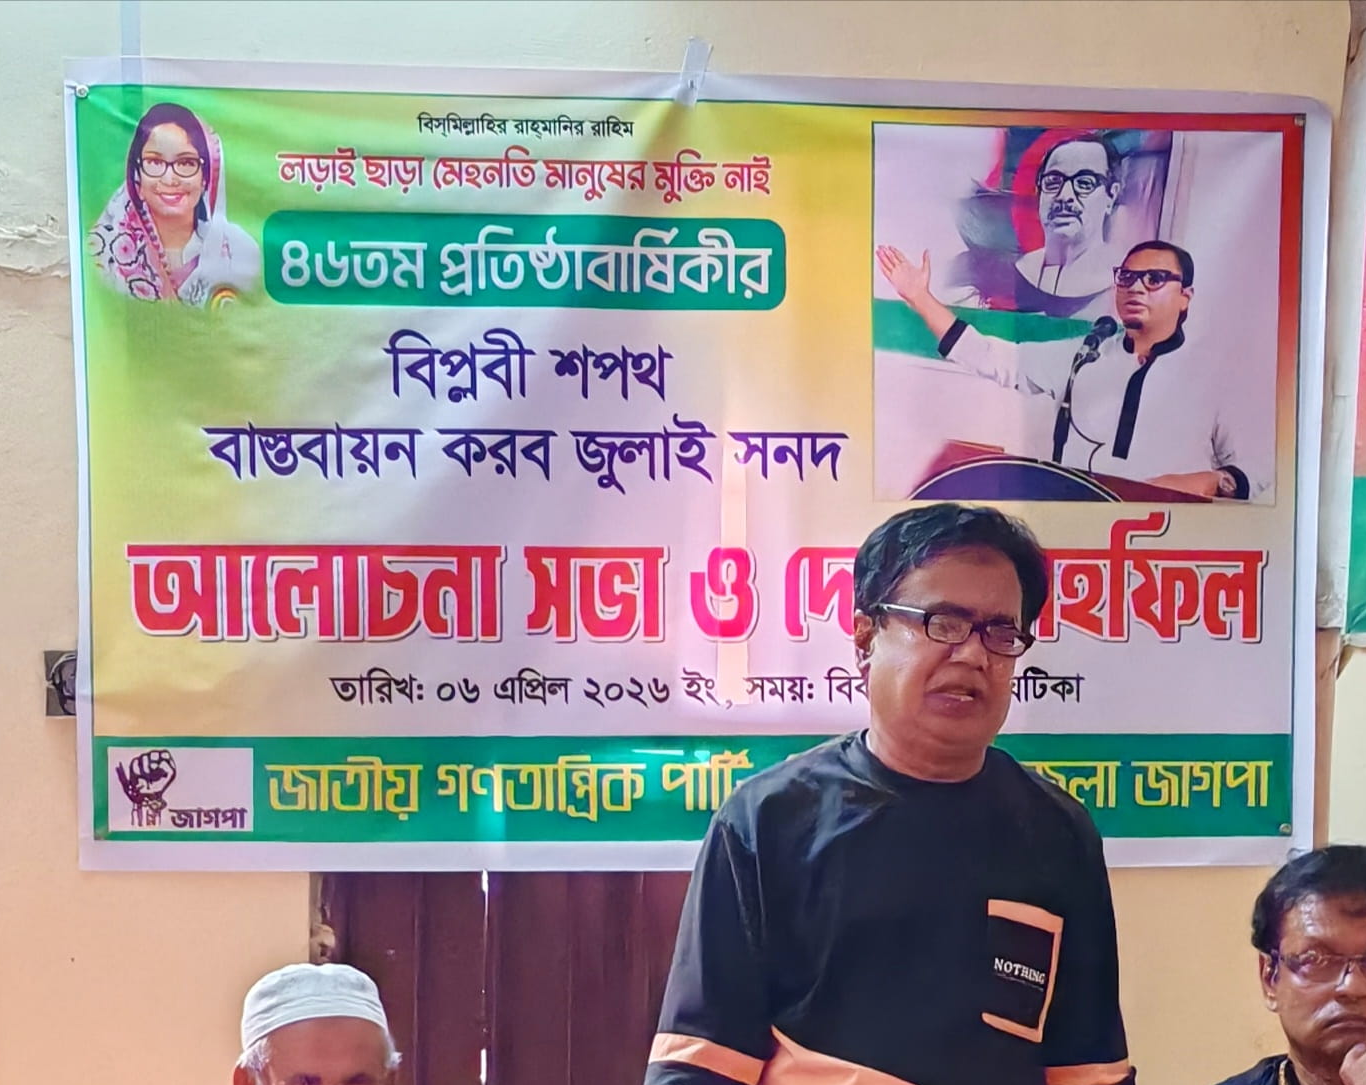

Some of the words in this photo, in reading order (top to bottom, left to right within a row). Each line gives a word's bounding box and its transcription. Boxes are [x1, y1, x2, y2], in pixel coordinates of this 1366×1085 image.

[590, 114, 635, 138] রাহিম
[276, 147, 356, 193] লড়াই
[362, 153, 425, 195] ছাড়া
[433, 144, 536, 192] মেহনতি
[543, 157, 647, 201] মানুষের
[653, 149, 716, 203] মুক্তি
[723, 156, 773, 195] নাই
[280, 238, 428, 290] ৪৬তম
[440, 224, 774, 300] প্রতিষ্ঠাবার্ষিকীর
[383, 327, 536, 404] বিপ্লবী
[548, 343, 675, 404] শপথ
[202, 421, 425, 481] বাস্তবায়ন
[435, 428, 558, 482] করব
[568, 413, 716, 496] জুলাই
[727, 430, 850, 482] সনদ
[125, 544, 505, 641] আলোচনা
[523, 546, 668, 641] সভা
[689, 546, 758, 641] ও
[436, 677, 481, 704] ০৬
[493, 667, 573, 705] এপ্রিল
[584, 676, 671, 709] ২০২৬
[169, 806, 248, 830] জাগপা
[264, 756, 423, 821] জাতীয়
[436, 754, 647, 823] গণতান্ত্রিক
[1130, 760, 1274, 809] জাগপা
